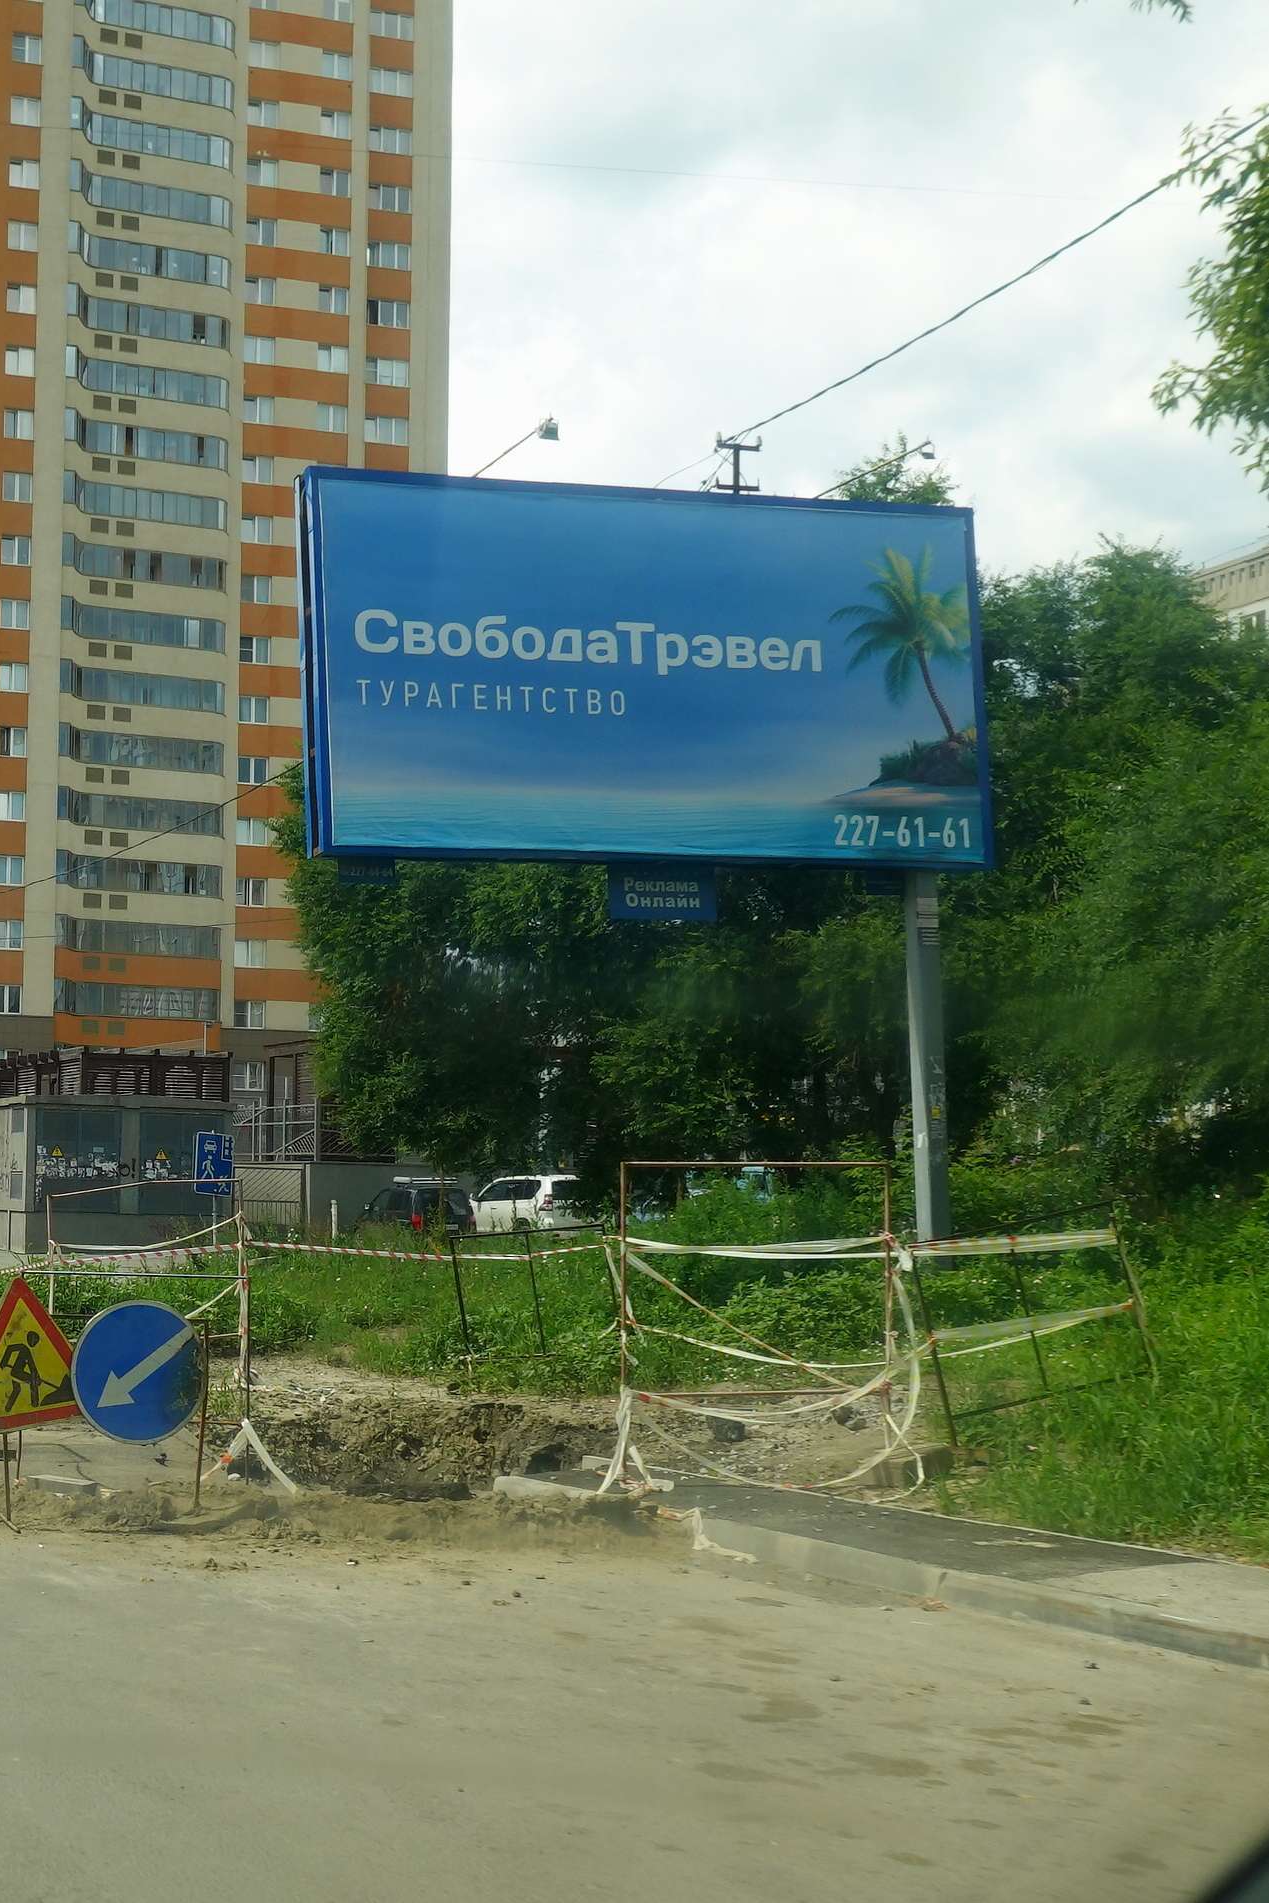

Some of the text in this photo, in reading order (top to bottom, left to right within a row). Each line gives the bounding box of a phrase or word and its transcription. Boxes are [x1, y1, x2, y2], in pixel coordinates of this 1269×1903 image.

[354, 608, 823, 676] СвободаТрэвел
[355, 678, 626, 716] ТУРАГЕНТСТВО
[834, 814, 971, 849] 227-61-61
[624, 877, 699, 892] Реклама
[625, 893, 701, 908] Онлайн
